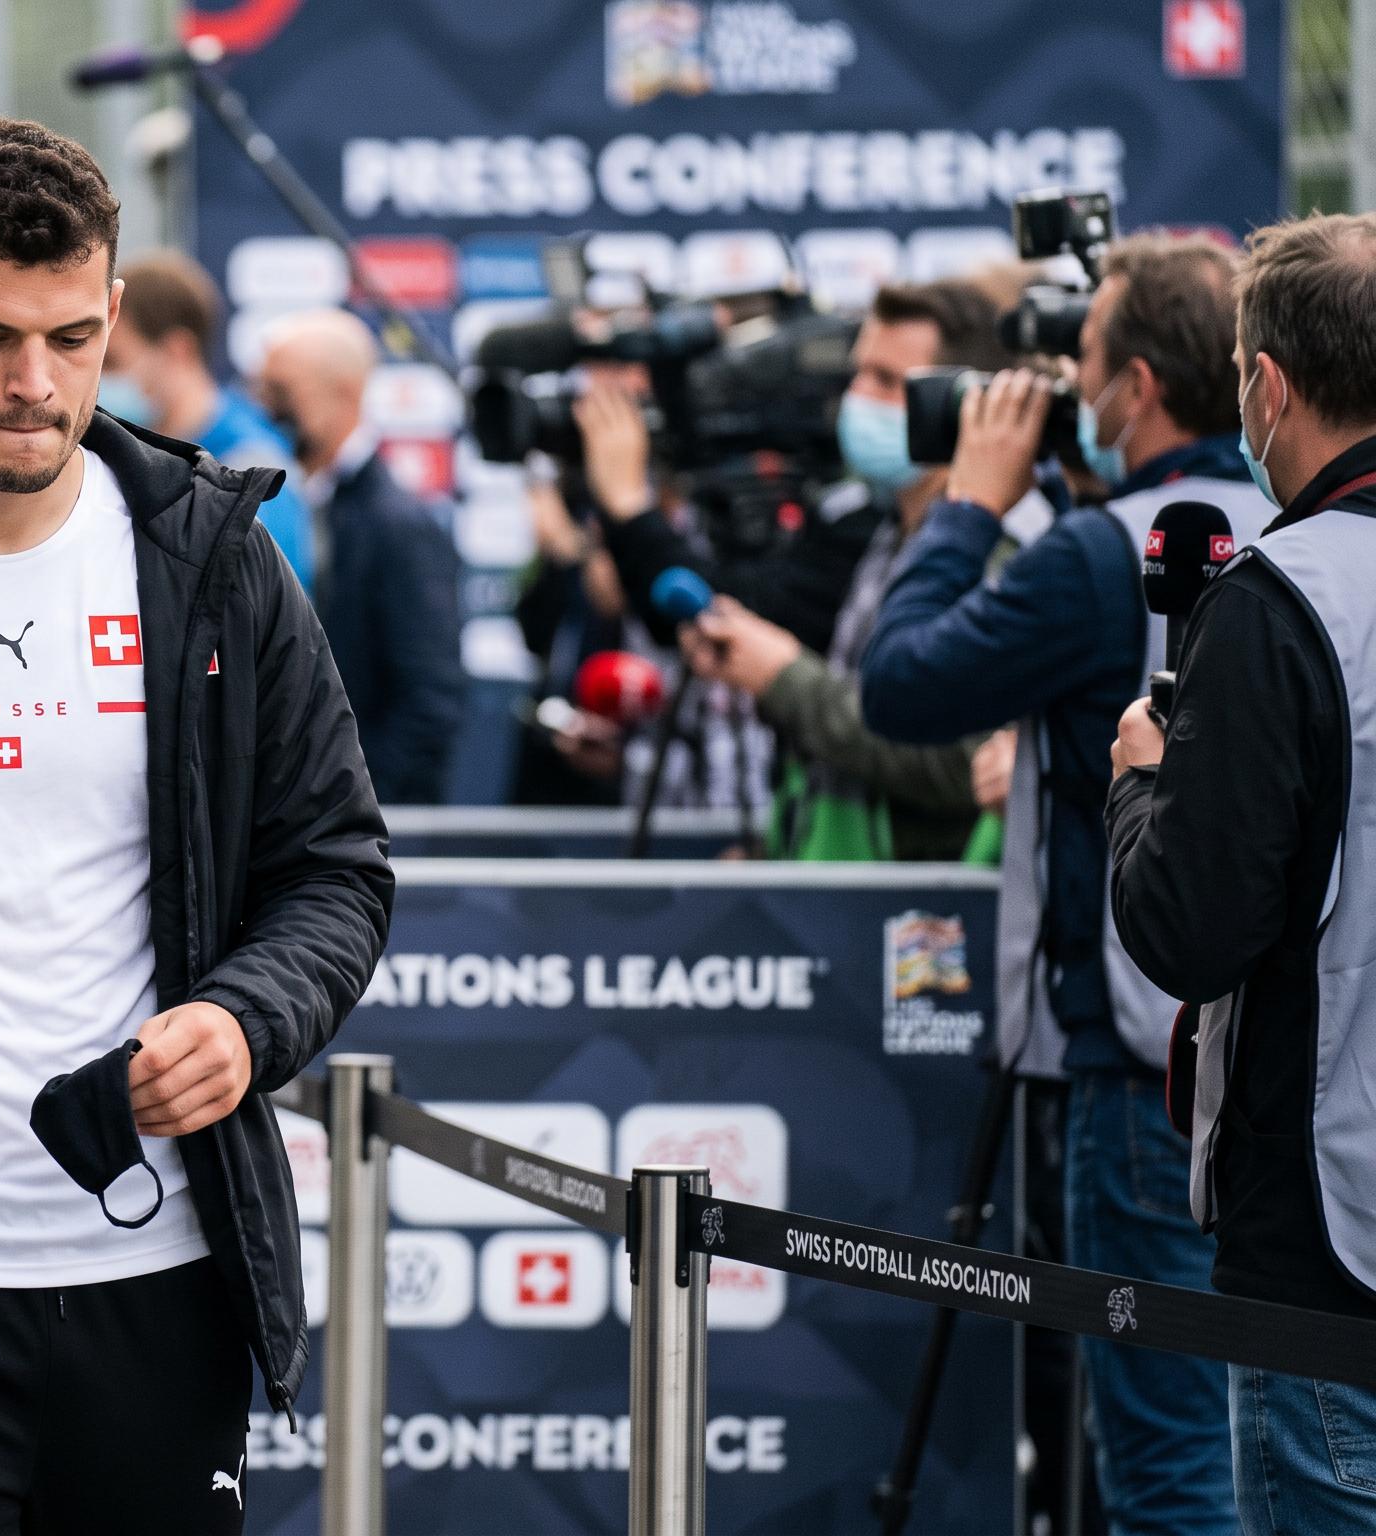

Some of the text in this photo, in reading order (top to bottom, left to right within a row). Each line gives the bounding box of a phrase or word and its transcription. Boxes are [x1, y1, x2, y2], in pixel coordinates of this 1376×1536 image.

[342, 128, 1126, 218] PRESS CONFERENCE
[352, 953, 814, 1010] ATIONS LEAGUE
[786, 1227, 1031, 1304] SWISS FOOTBALL ASSOCIATION
